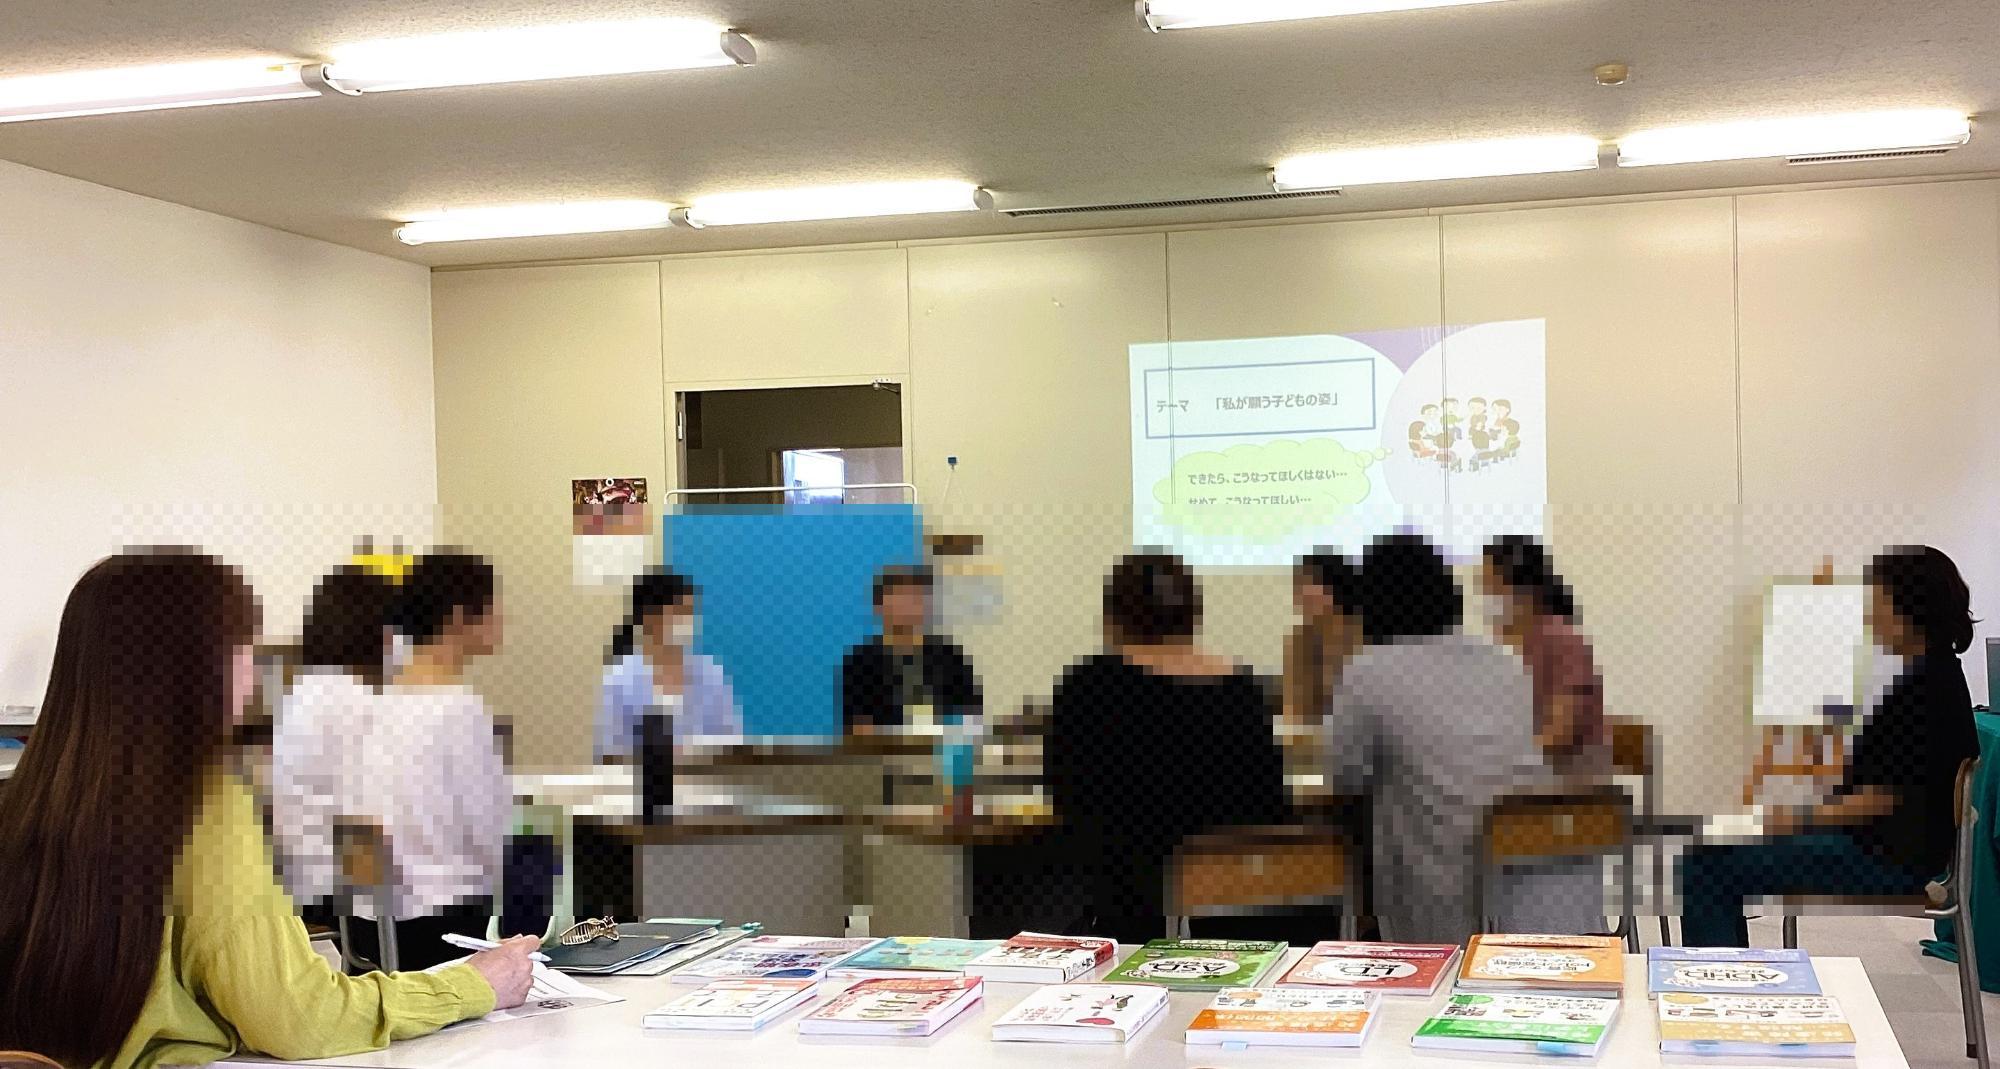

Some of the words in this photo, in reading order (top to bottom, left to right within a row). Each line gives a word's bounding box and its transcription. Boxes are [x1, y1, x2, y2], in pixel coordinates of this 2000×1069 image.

[1156, 399, 1190, 413] テーマ
[1216, 392, 1338, 410] 「私が願う子どもの姿」
[1152, 964, 1227, 972] ASD
[1339, 967, 1394, 976] LD
[1684, 971, 1780, 980] ADHD
